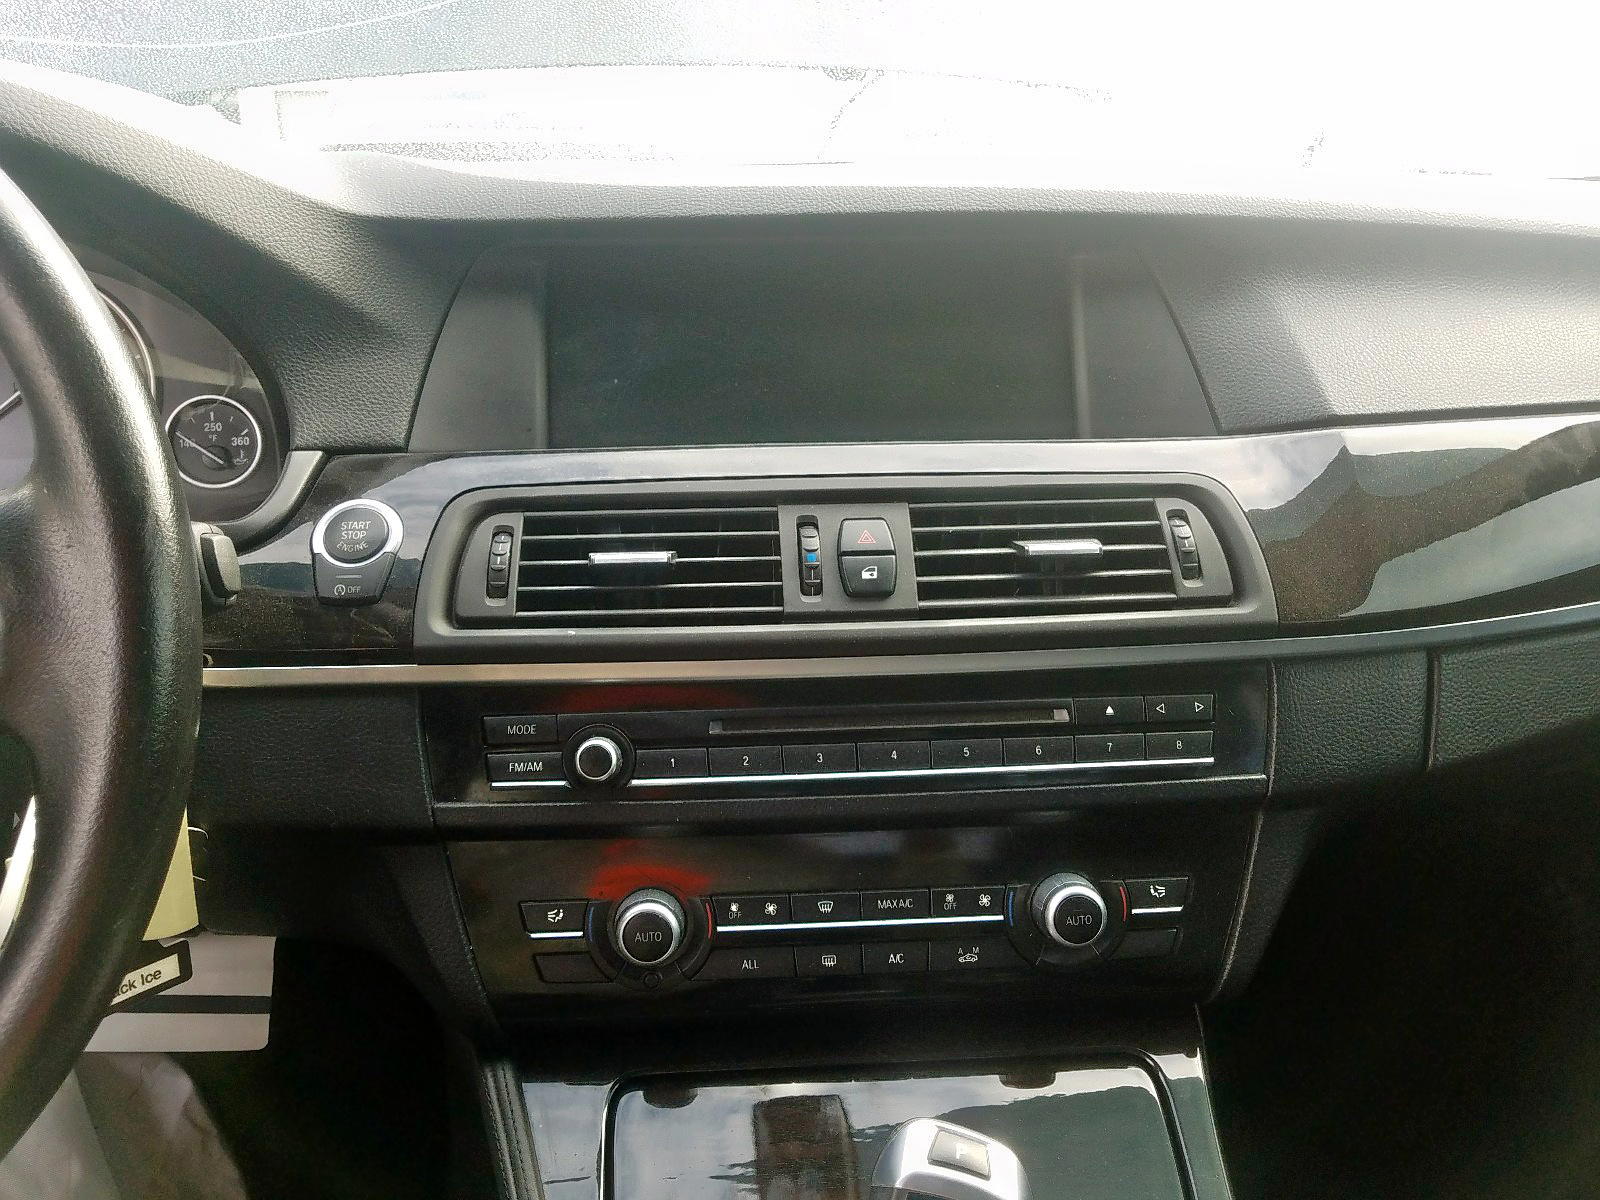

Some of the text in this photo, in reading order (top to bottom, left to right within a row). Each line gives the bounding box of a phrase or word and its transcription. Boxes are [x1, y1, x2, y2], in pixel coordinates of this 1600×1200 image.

[203, 422, 223, 432] 250
[231, 436, 250, 447] 360
[340, 520, 372, 530] START
[341, 530, 367, 540] STOP
[336, 540, 369, 553] ENGINE
[347, 586, 361, 595] OFF
[507, 724, 537, 735] MODE
[1035, 745, 1042, 755] 6
[1106, 742, 1113, 752] 7
[1175, 740, 1182, 750] 8
[816, 752, 823, 763] 3
[891, 750, 897, 760] 4
[963, 747, 970, 757] 5
[670, 757, 676, 768] 1
[742, 755, 749, 766] 2
[509, 761, 543, 773] FM/AM
[877, 898, 914, 909] MAX A/C
[943, 902, 957, 911] OFF
[728, 911, 742, 920] OFF
[1065, 914, 1093, 926] AUTO
[634, 931, 662, 943] AUTO
[957, 946, 980, 955] A M
[888, 953, 905, 964] A/C
[741, 959, 760, 970] ALL
[117, 969, 162, 996] ck Ice
